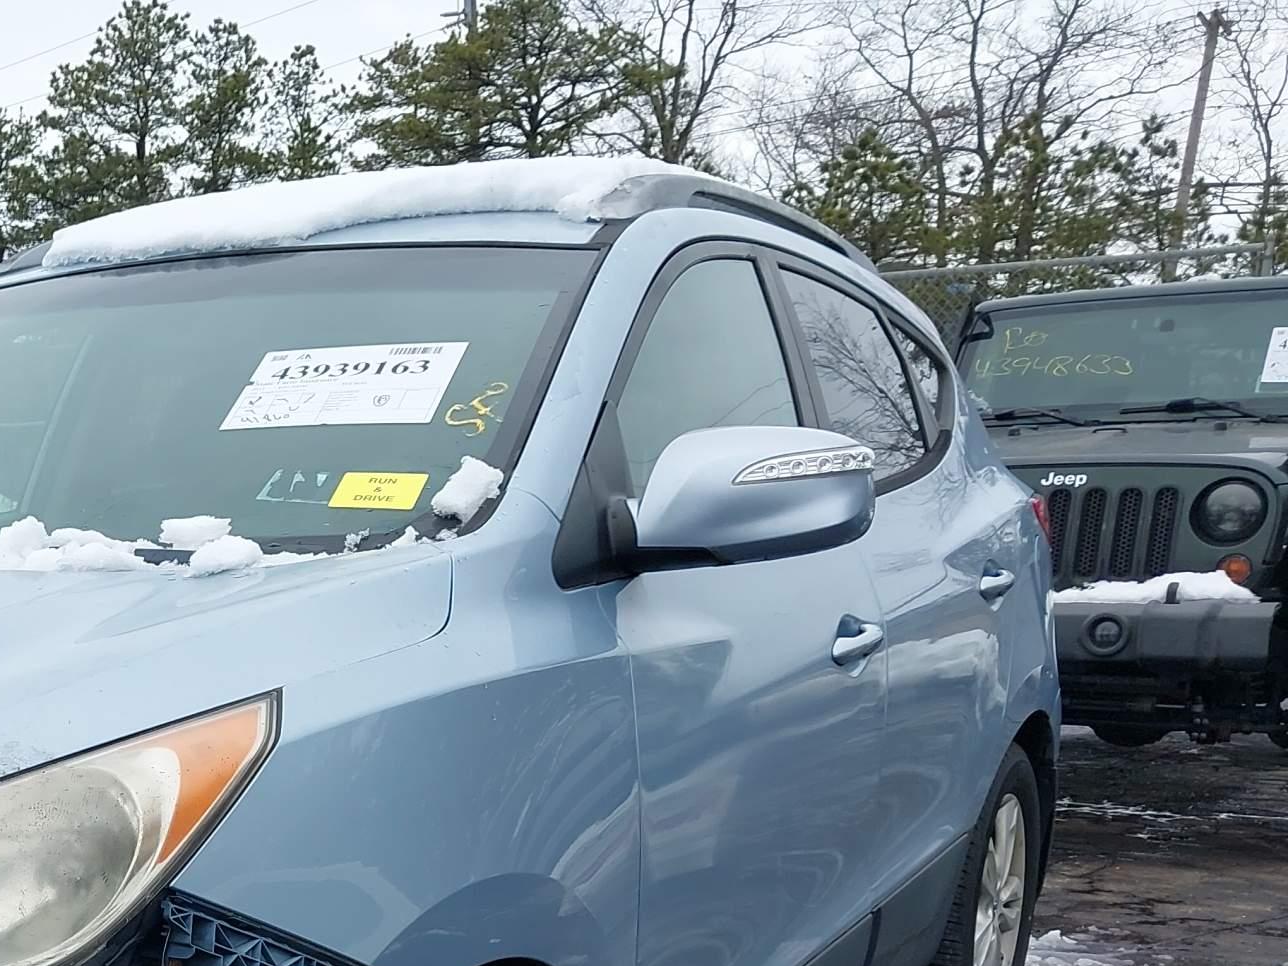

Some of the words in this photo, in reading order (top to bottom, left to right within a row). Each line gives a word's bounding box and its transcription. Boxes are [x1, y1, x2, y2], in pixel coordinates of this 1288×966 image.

[271, 359, 431, 381] 43939163
[975, 353, 1134, 377] 43948633
[368, 477, 398, 485] RUN
[1040, 471, 1088, 488] Jeep
[352, 494, 395, 502] DRIVE
